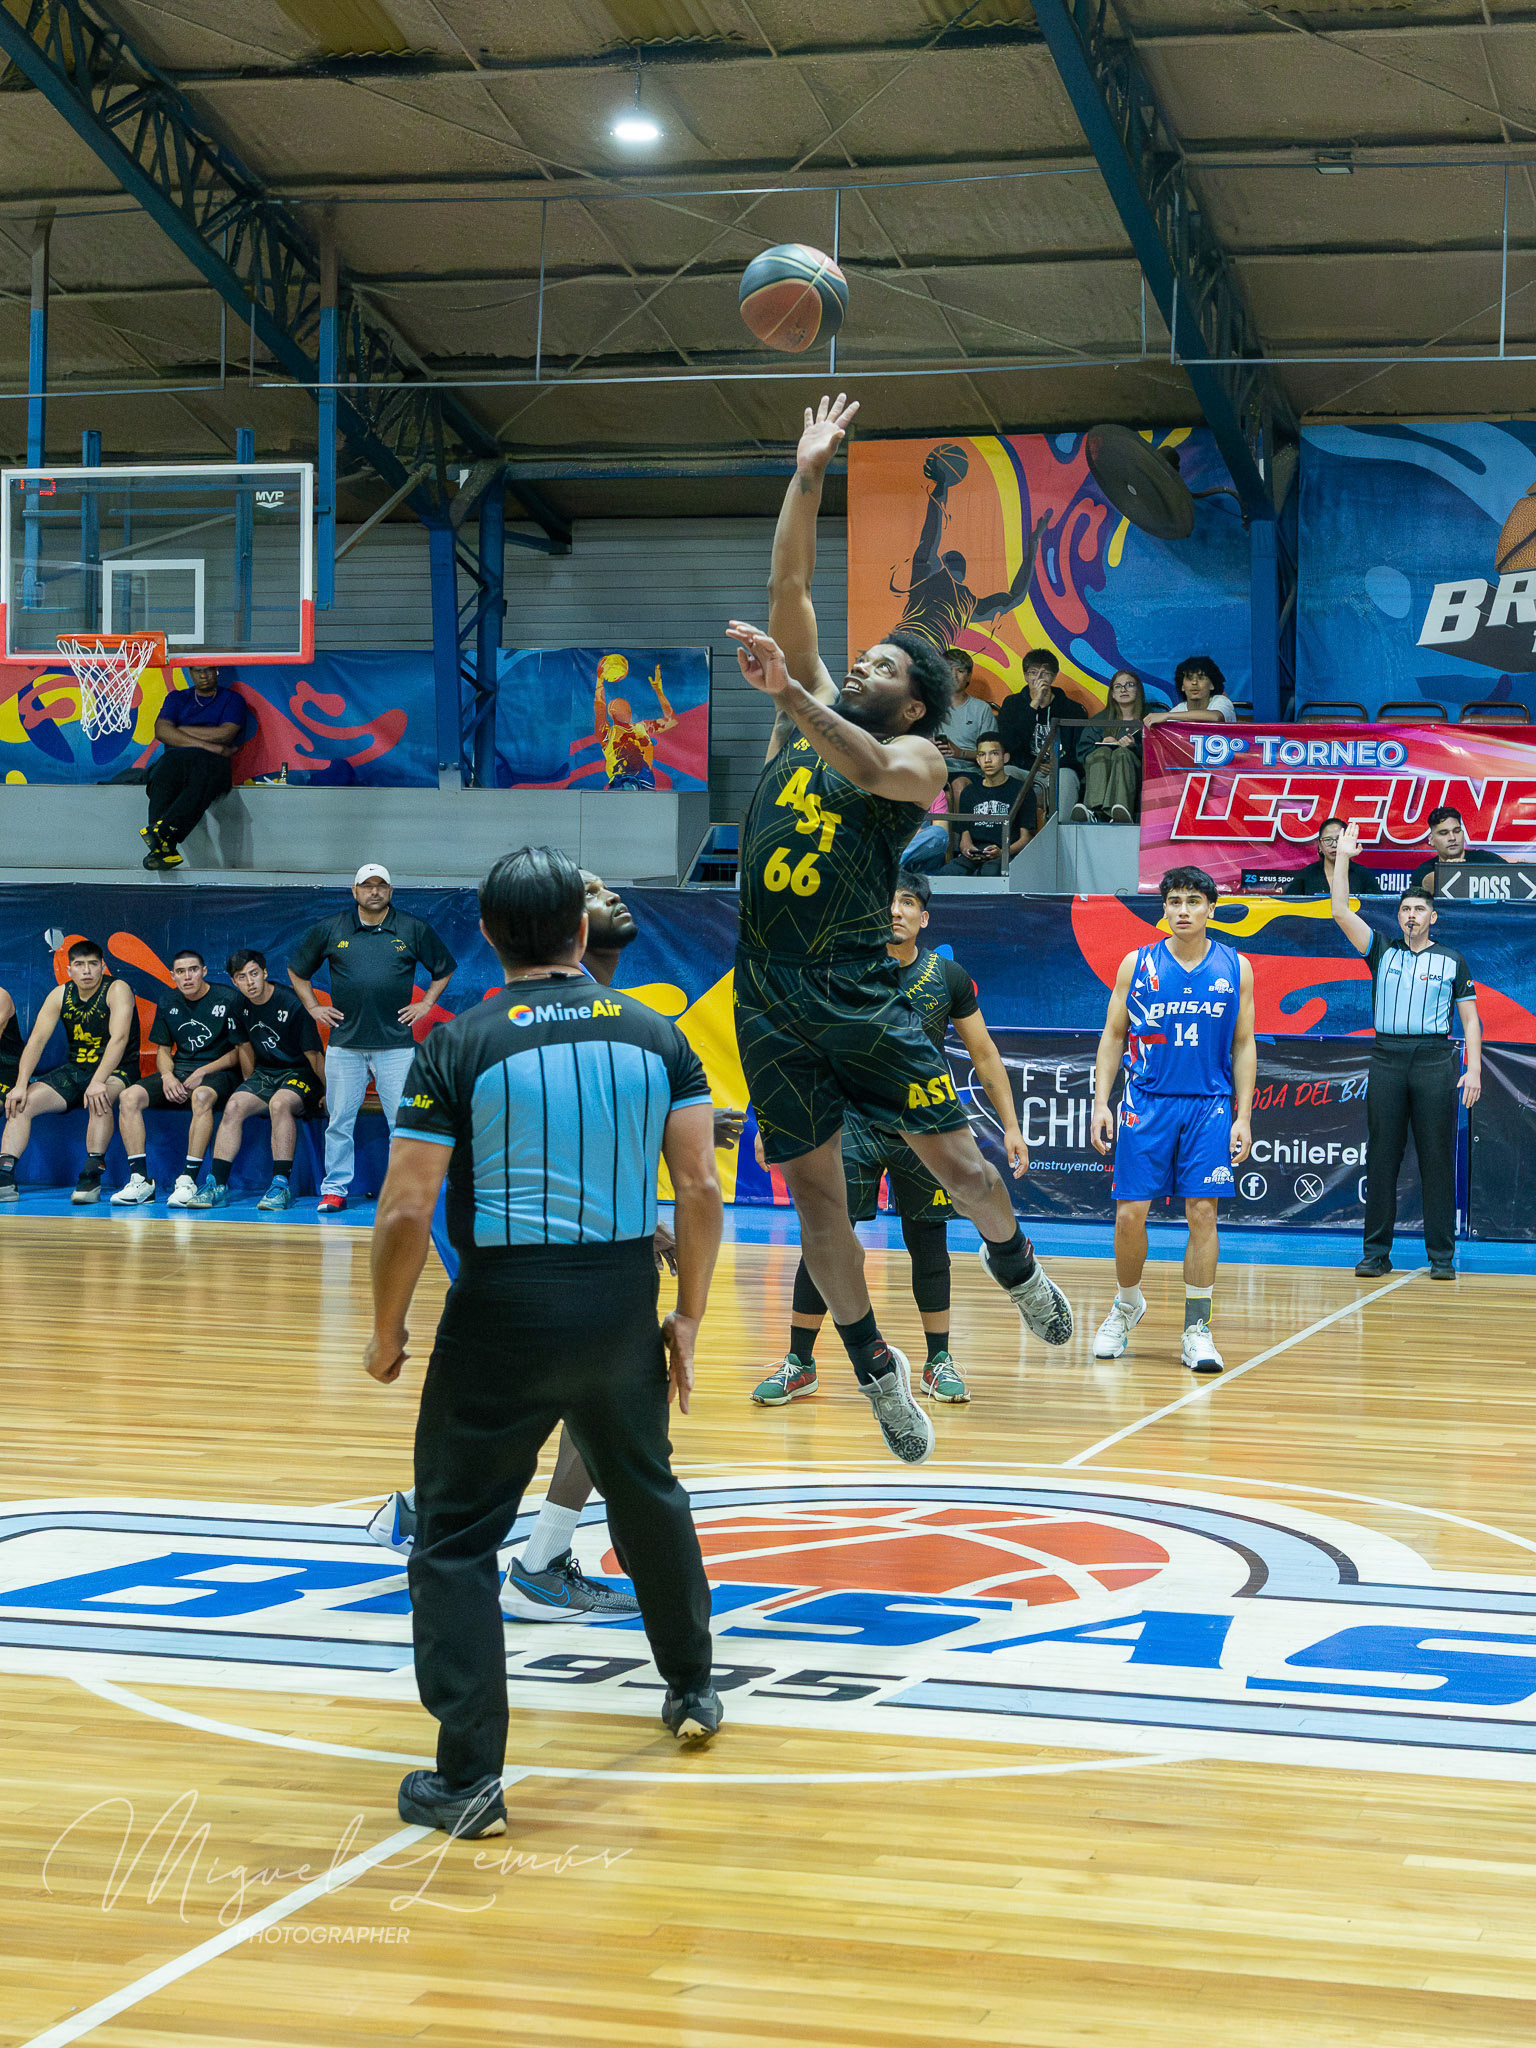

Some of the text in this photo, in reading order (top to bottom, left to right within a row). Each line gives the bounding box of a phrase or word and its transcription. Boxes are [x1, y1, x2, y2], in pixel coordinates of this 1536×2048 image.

[255, 491, 285, 502] MVP
[775, 766, 842, 853] AST
[1170, 773, 1536, 846] LEJEUNE
[763, 846, 821, 897] 66
[1469, 875, 1511, 899] POSS
[211, 1004, 226, 1017] 49
[277, 1009, 289, 1023] 37
[535, 999, 623, 1024] MineAir
[1147, 1001, 1227, 1018] BRISAS
[1174, 1022, 1199, 1047] 14
[287, 1078, 311, 1094] AST
[908, 1073, 957, 1110] AST
[1294, 1080, 1333, 1106] DEL
